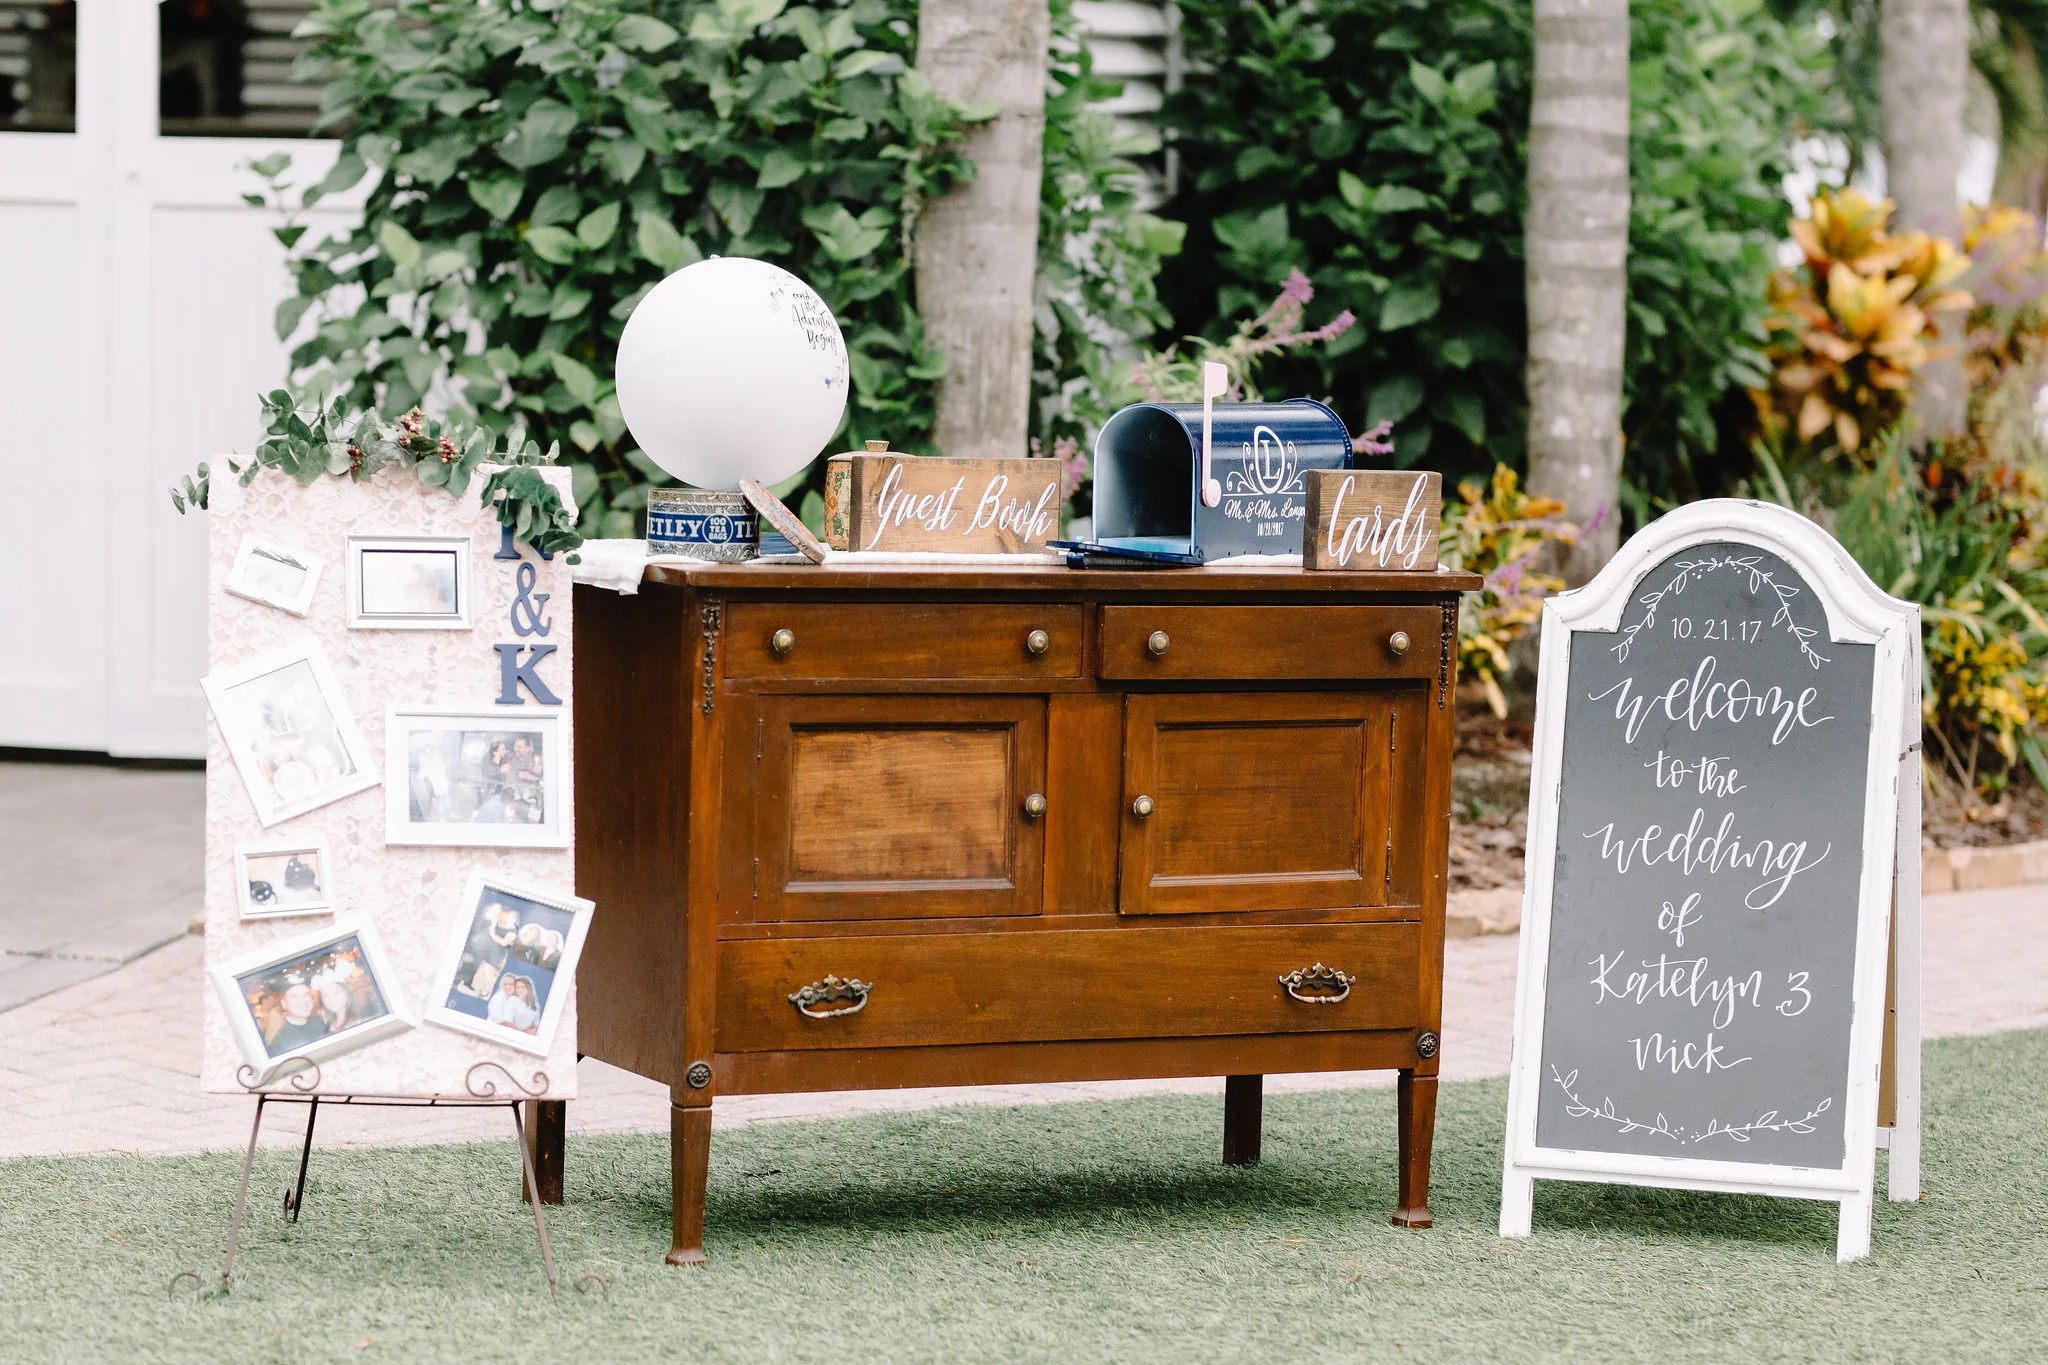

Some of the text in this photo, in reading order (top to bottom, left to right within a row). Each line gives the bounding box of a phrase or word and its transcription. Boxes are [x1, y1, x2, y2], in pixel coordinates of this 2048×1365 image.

[806, 329, 838, 356] Begins
[708, 533, 728, 541] BAGS
[710, 517, 726, 526] 100
[865, 463, 965, 550] Guest
[963, 474, 1056, 544] Book
[1225, 499, 1245, 520] Mr.
[1245, 501, 1255, 523] &
[1254, 500, 1279, 520] Mrs.
[1327, 473, 1432, 570] Cards
[511, 561, 552, 637] &
[493, 643, 563, 705] K
[1588, 655, 1836, 746] welcome
[1644, 750, 1747, 798] to the
[1582, 807, 1831, 910] wedding
[1657, 892, 1703, 947] of
[1587, 950, 1762, 1029] Katelyn
